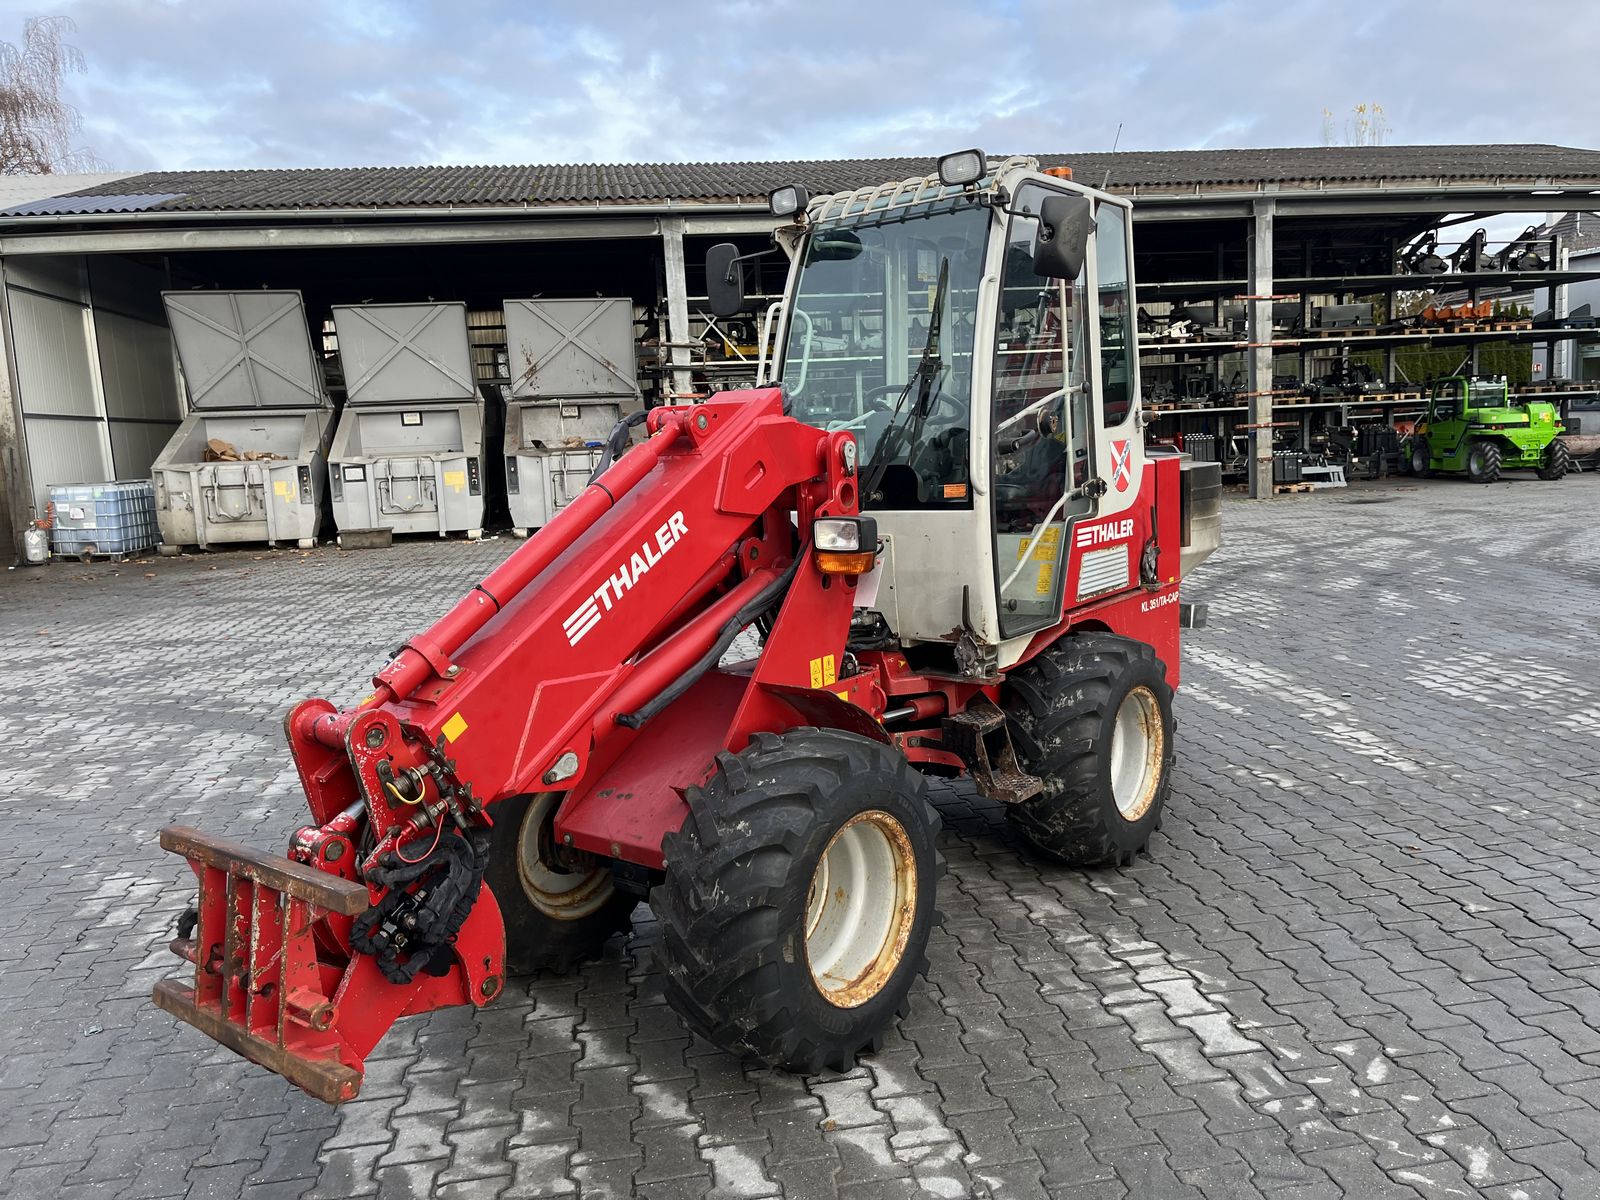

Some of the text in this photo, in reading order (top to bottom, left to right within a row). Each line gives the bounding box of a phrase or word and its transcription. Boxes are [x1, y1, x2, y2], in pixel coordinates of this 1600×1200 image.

[1091, 518, 1133, 543] THALER
[593, 510, 689, 612] THALER
[1141, 601, 1149, 613] KL
